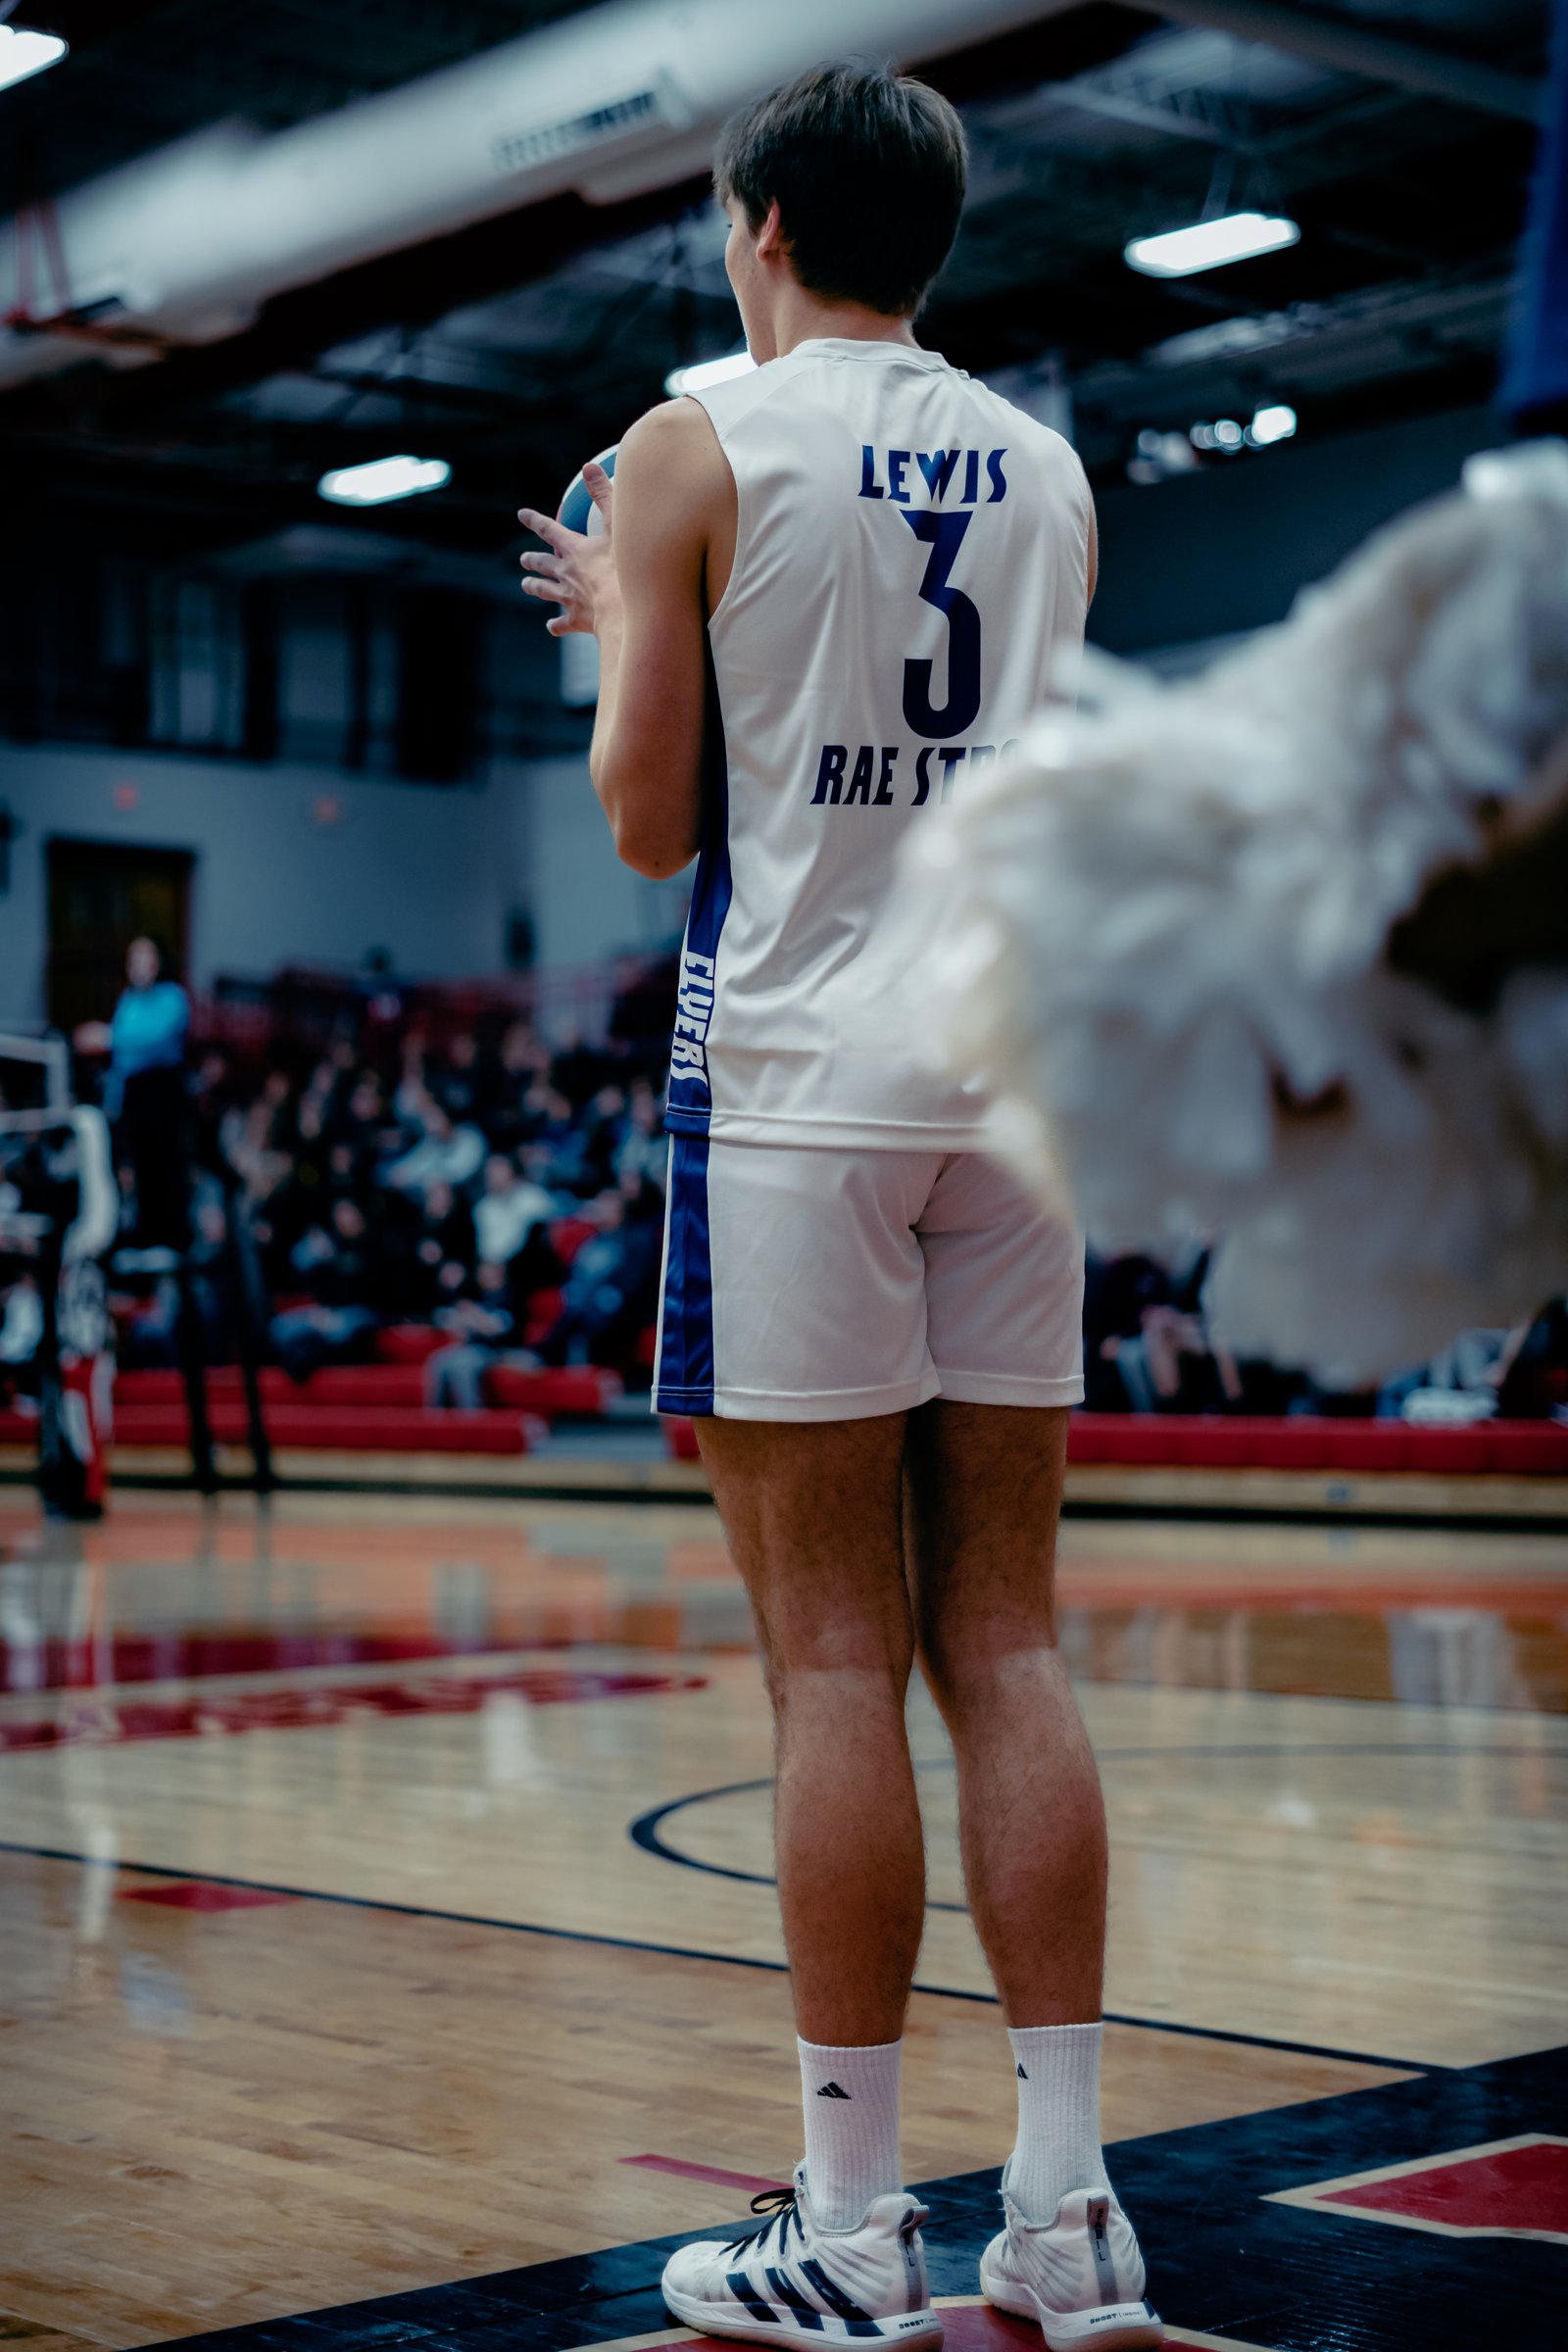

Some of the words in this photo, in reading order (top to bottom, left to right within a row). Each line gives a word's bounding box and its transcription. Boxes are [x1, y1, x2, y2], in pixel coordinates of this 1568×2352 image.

[858, 445, 1008, 504] LEWIS
[899, 509, 981, 739] 3
[809, 745, 900, 806] RAE
[910, 738, 1023, 806] ST
[670, 951, 714, 1088] FLYERS
